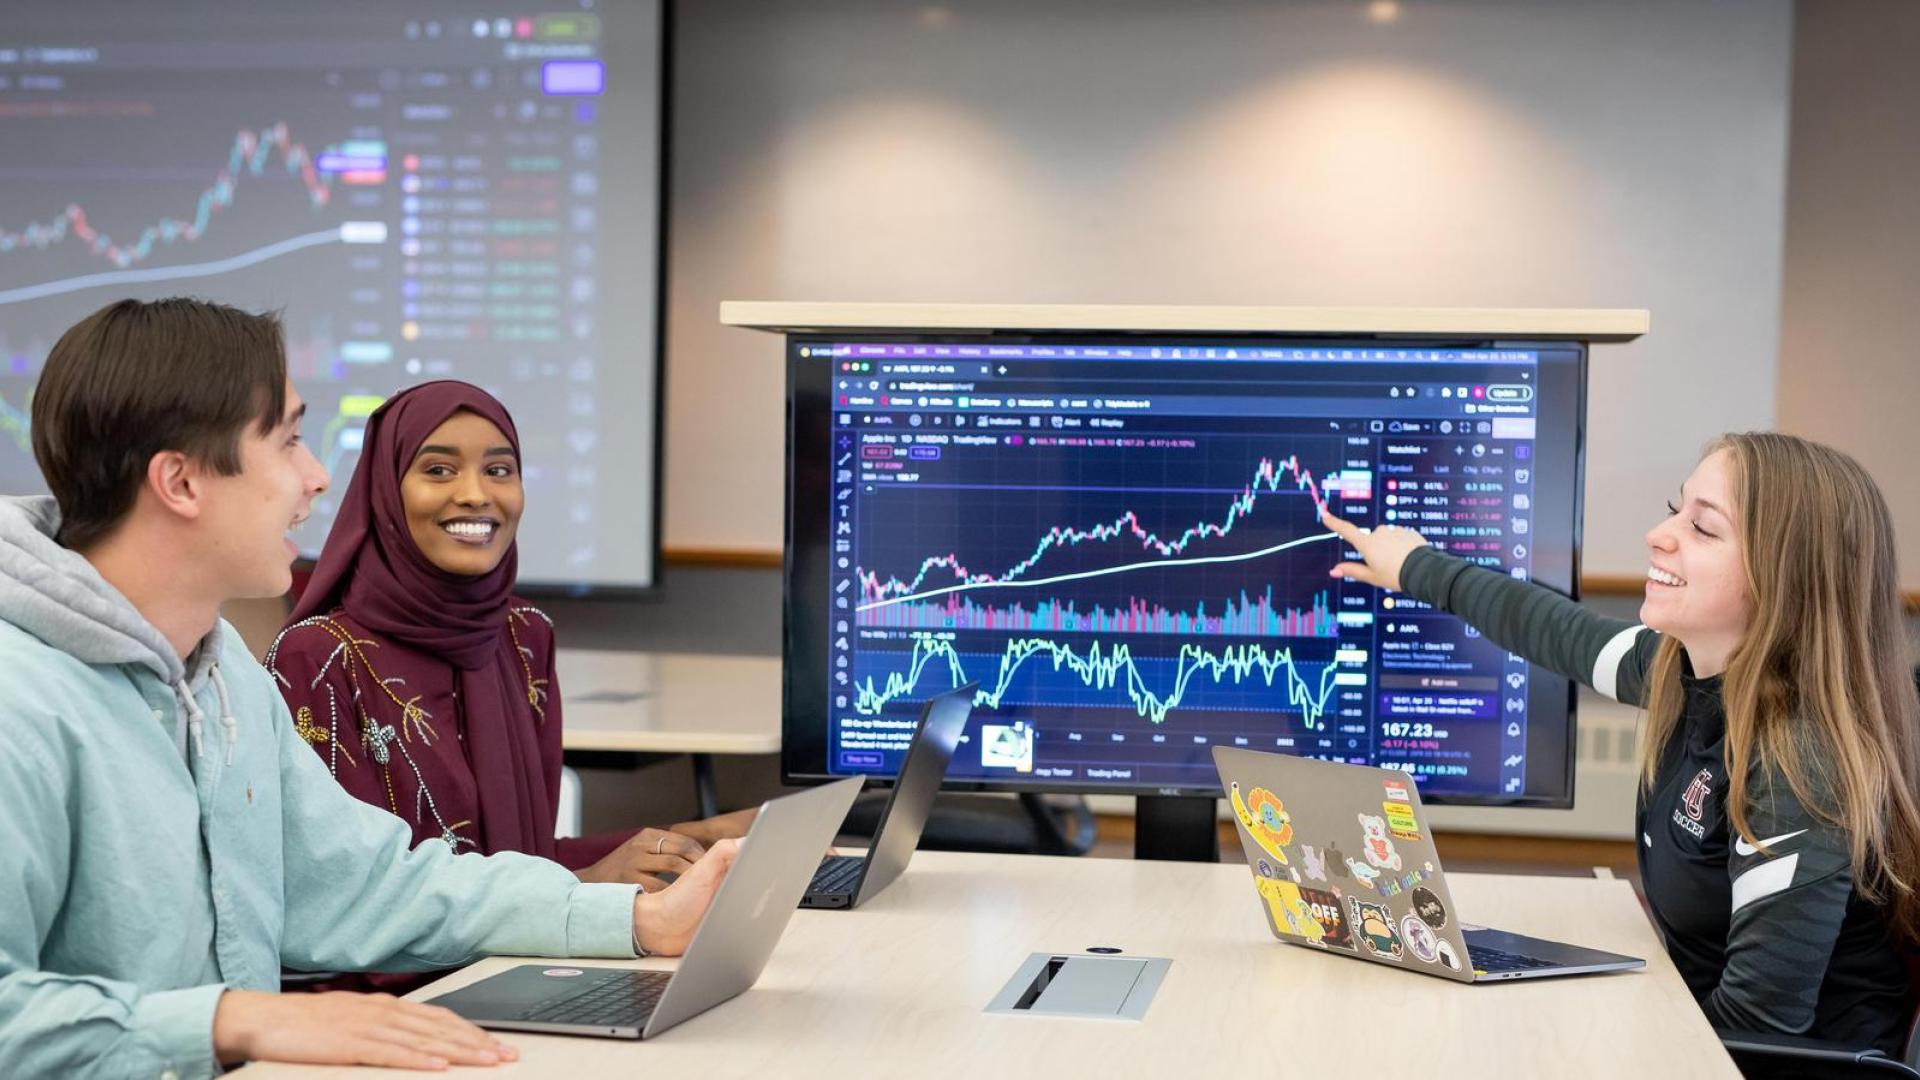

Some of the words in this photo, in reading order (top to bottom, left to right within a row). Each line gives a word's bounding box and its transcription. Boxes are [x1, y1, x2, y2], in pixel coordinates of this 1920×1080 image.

[1399, 624, 1419, 633] AAPL
[1381, 722, 1433, 737] 167.23
[1087, 768, 1111, 778] Trading
[1672, 809, 1706, 840] SOCCER
